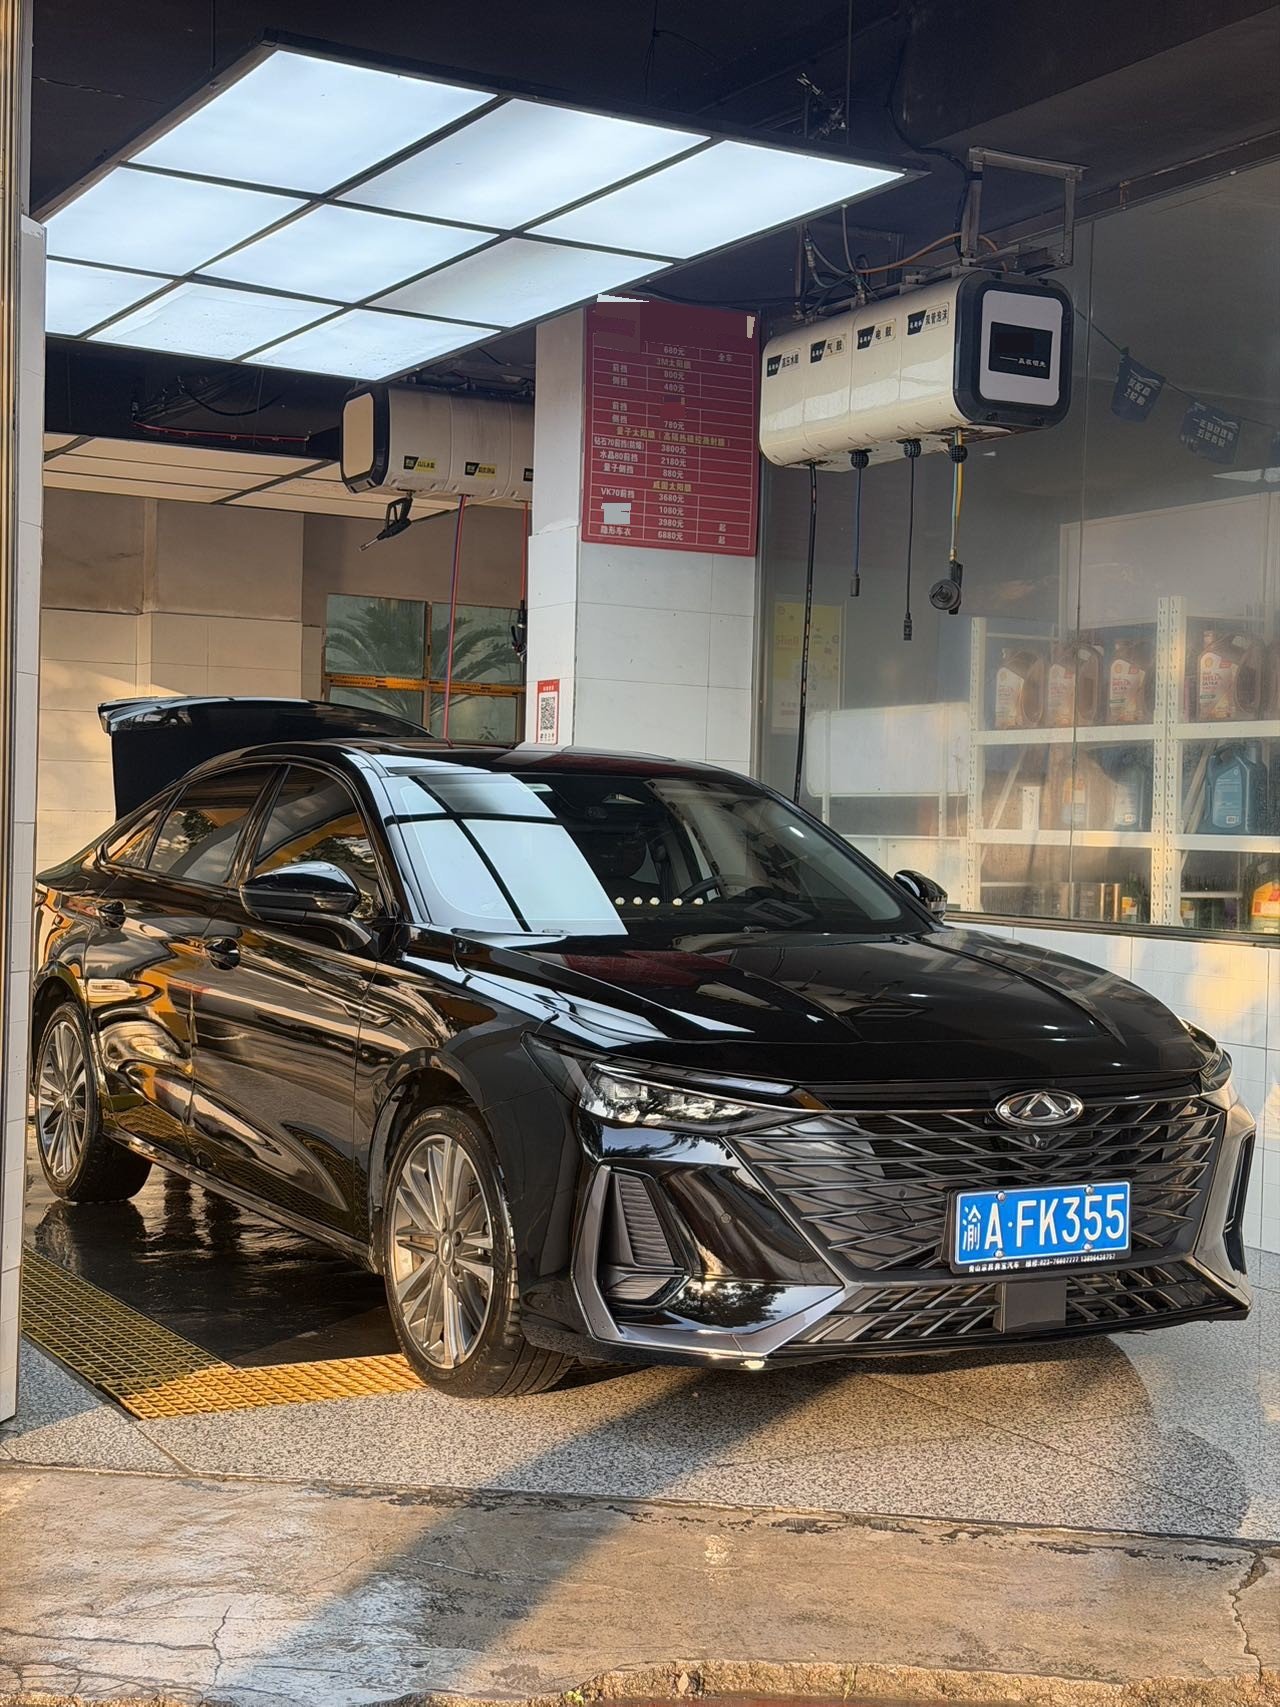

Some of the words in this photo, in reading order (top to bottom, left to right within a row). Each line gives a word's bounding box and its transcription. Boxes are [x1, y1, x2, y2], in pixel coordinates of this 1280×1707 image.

[661, 457, 687, 468] 2180元
[663, 470, 684, 479] 880元
[962, 1194, 1125, 1251] 渝A·FK355
